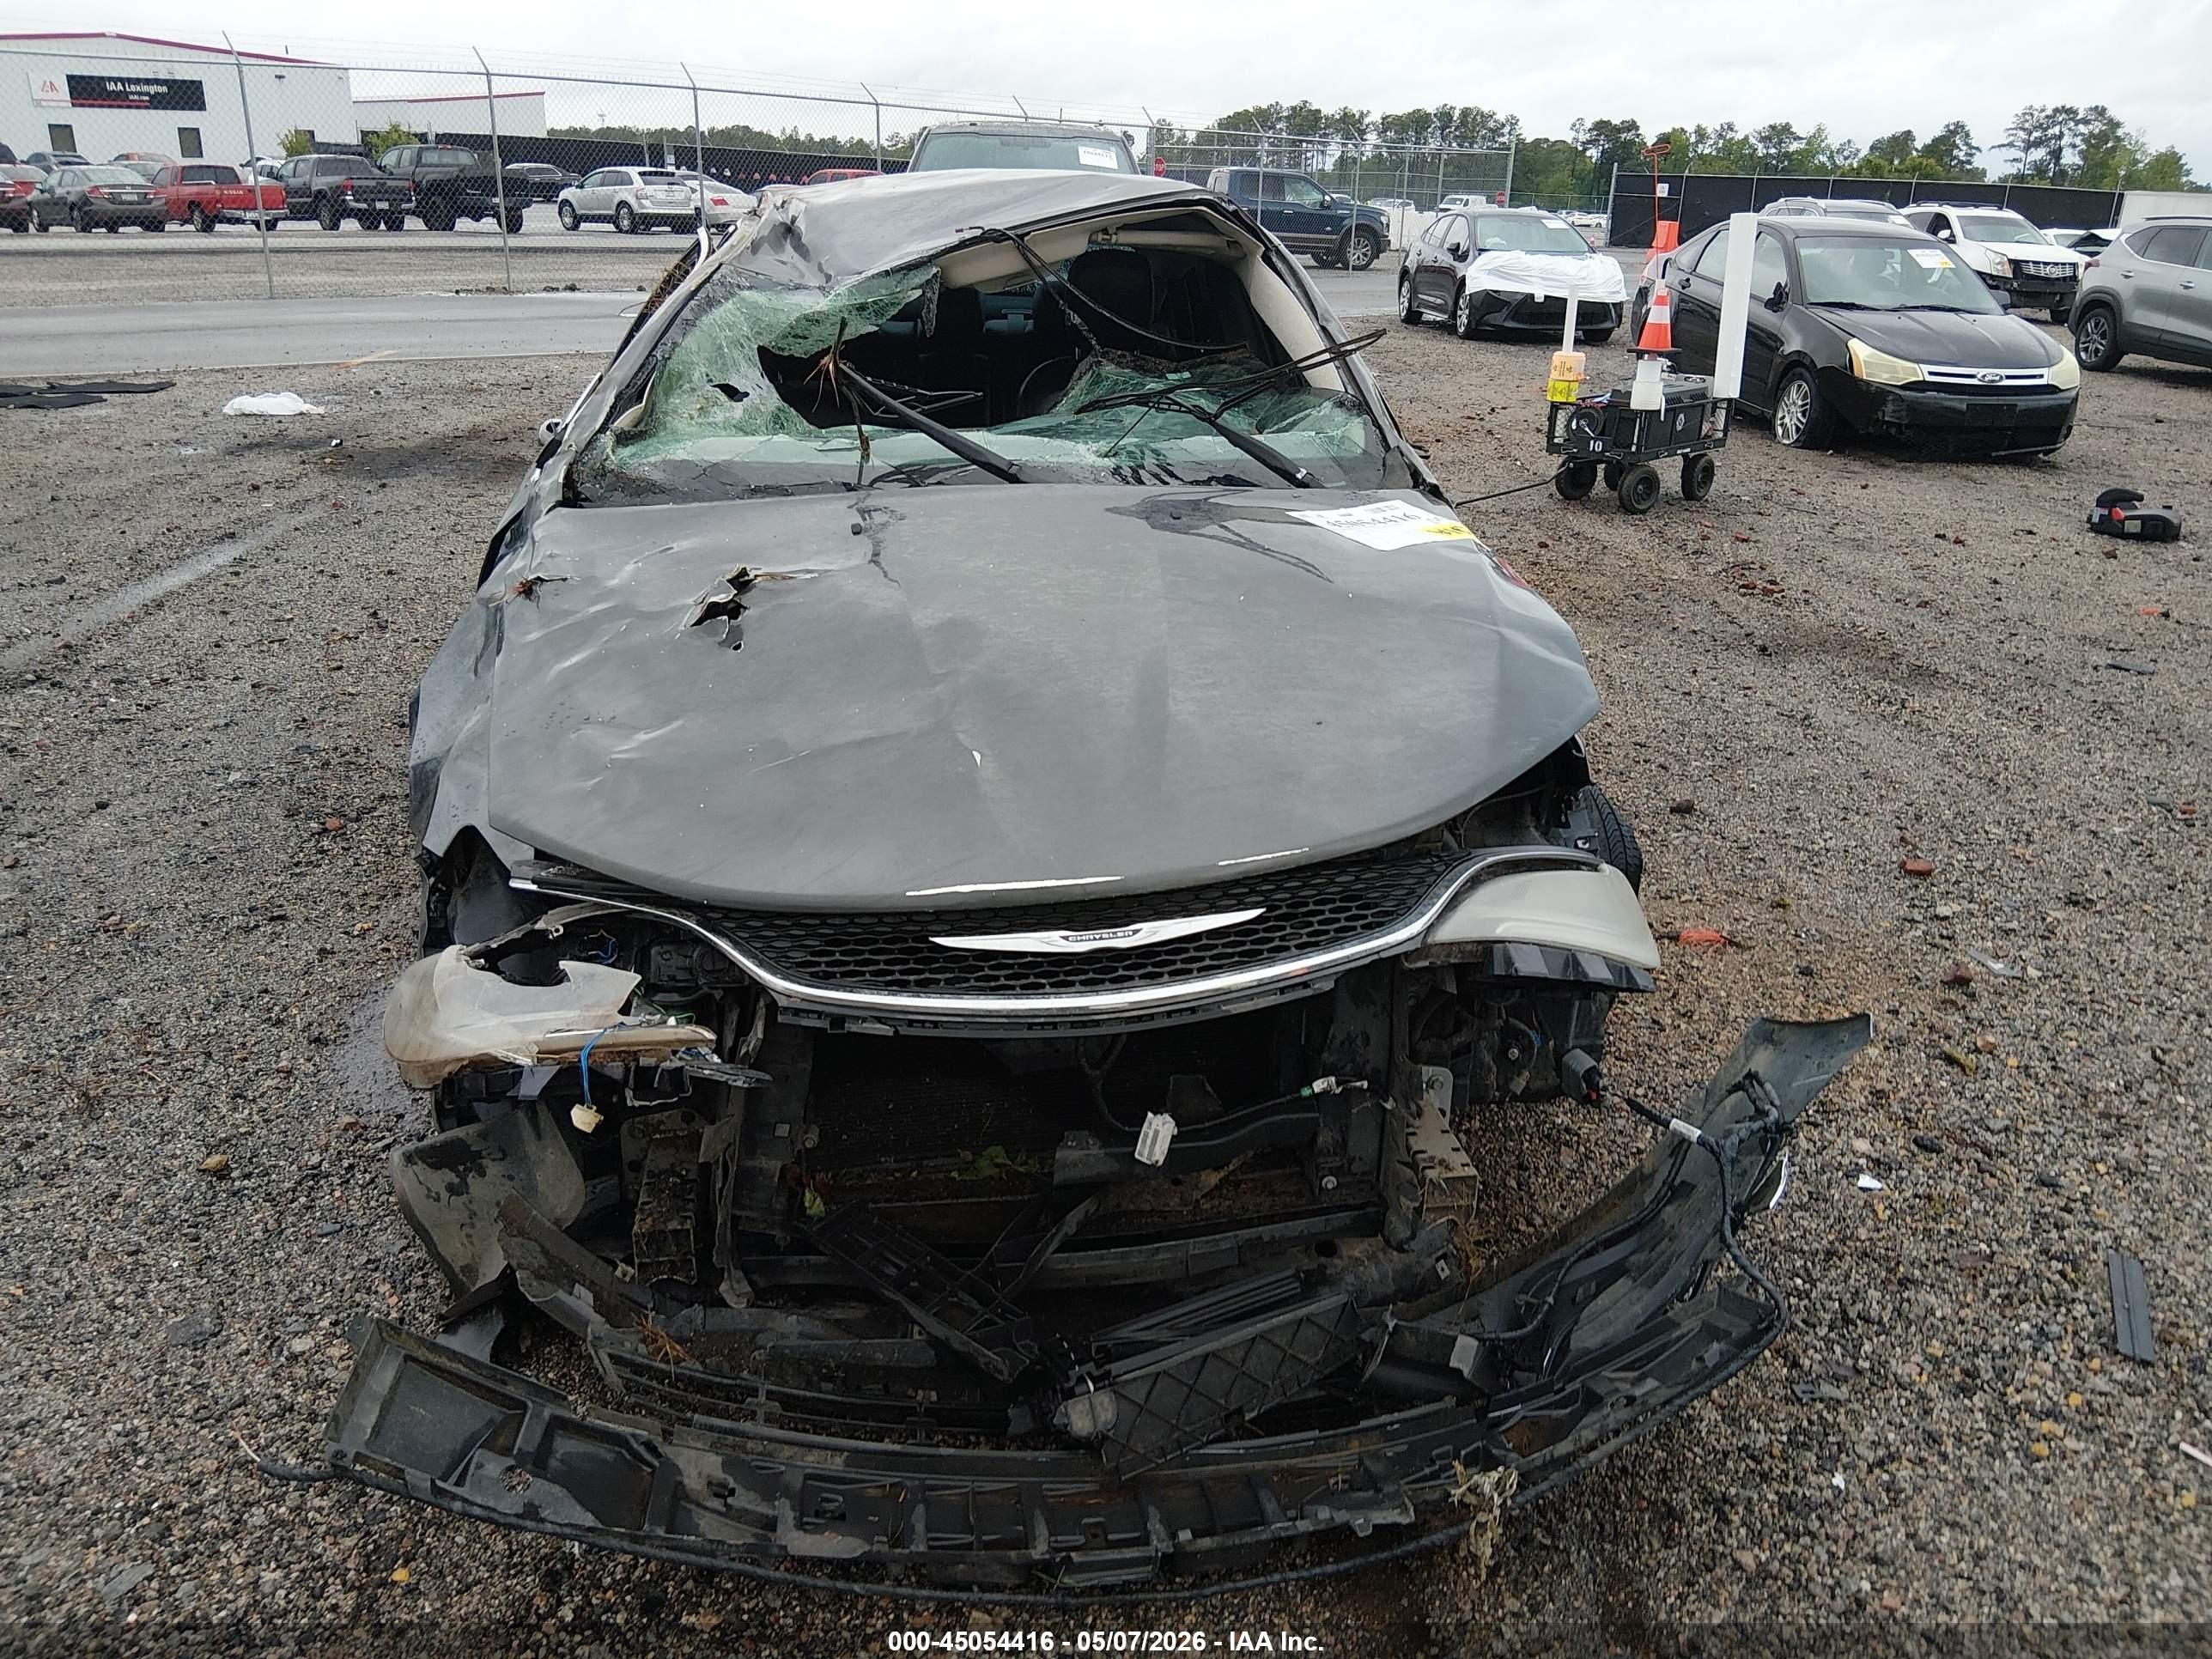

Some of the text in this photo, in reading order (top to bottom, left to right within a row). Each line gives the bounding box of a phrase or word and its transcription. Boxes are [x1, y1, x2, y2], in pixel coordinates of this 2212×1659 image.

[106, 81, 168, 94] IAA Lexington
[1589, 439, 1602, 452] 10
[1068, 930, 1133, 942] CHRYSLER
